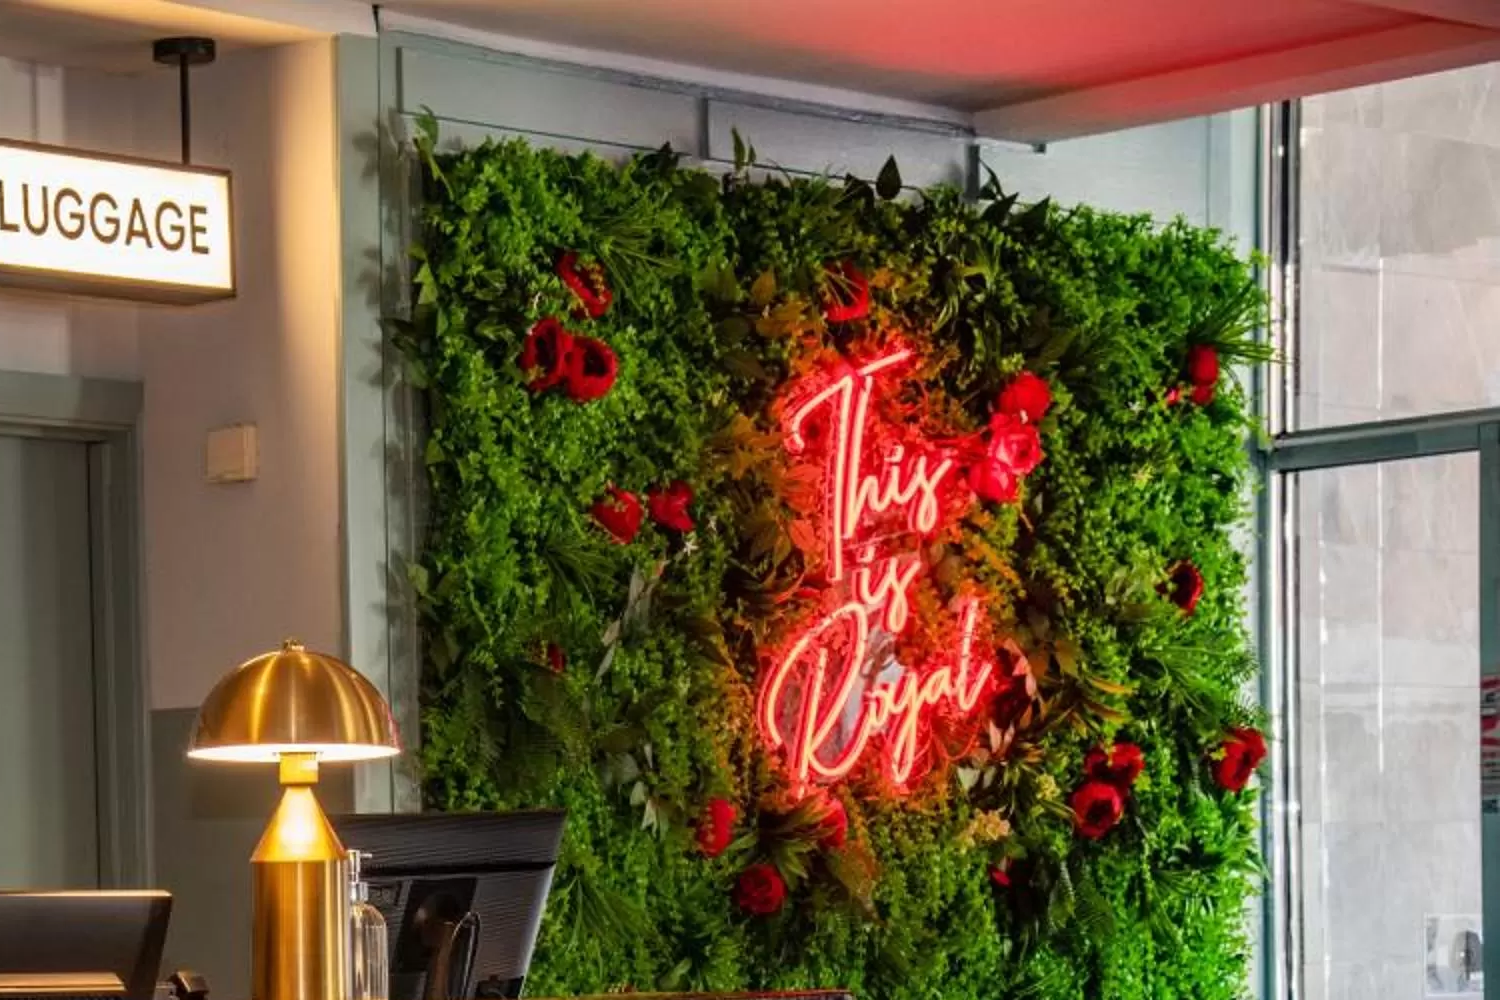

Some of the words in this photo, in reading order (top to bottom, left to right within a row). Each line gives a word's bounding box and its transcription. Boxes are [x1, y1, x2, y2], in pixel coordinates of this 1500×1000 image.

[790, 348, 953, 582] This
[860, 549, 922, 632] is
[765, 600, 993, 800] Royal
